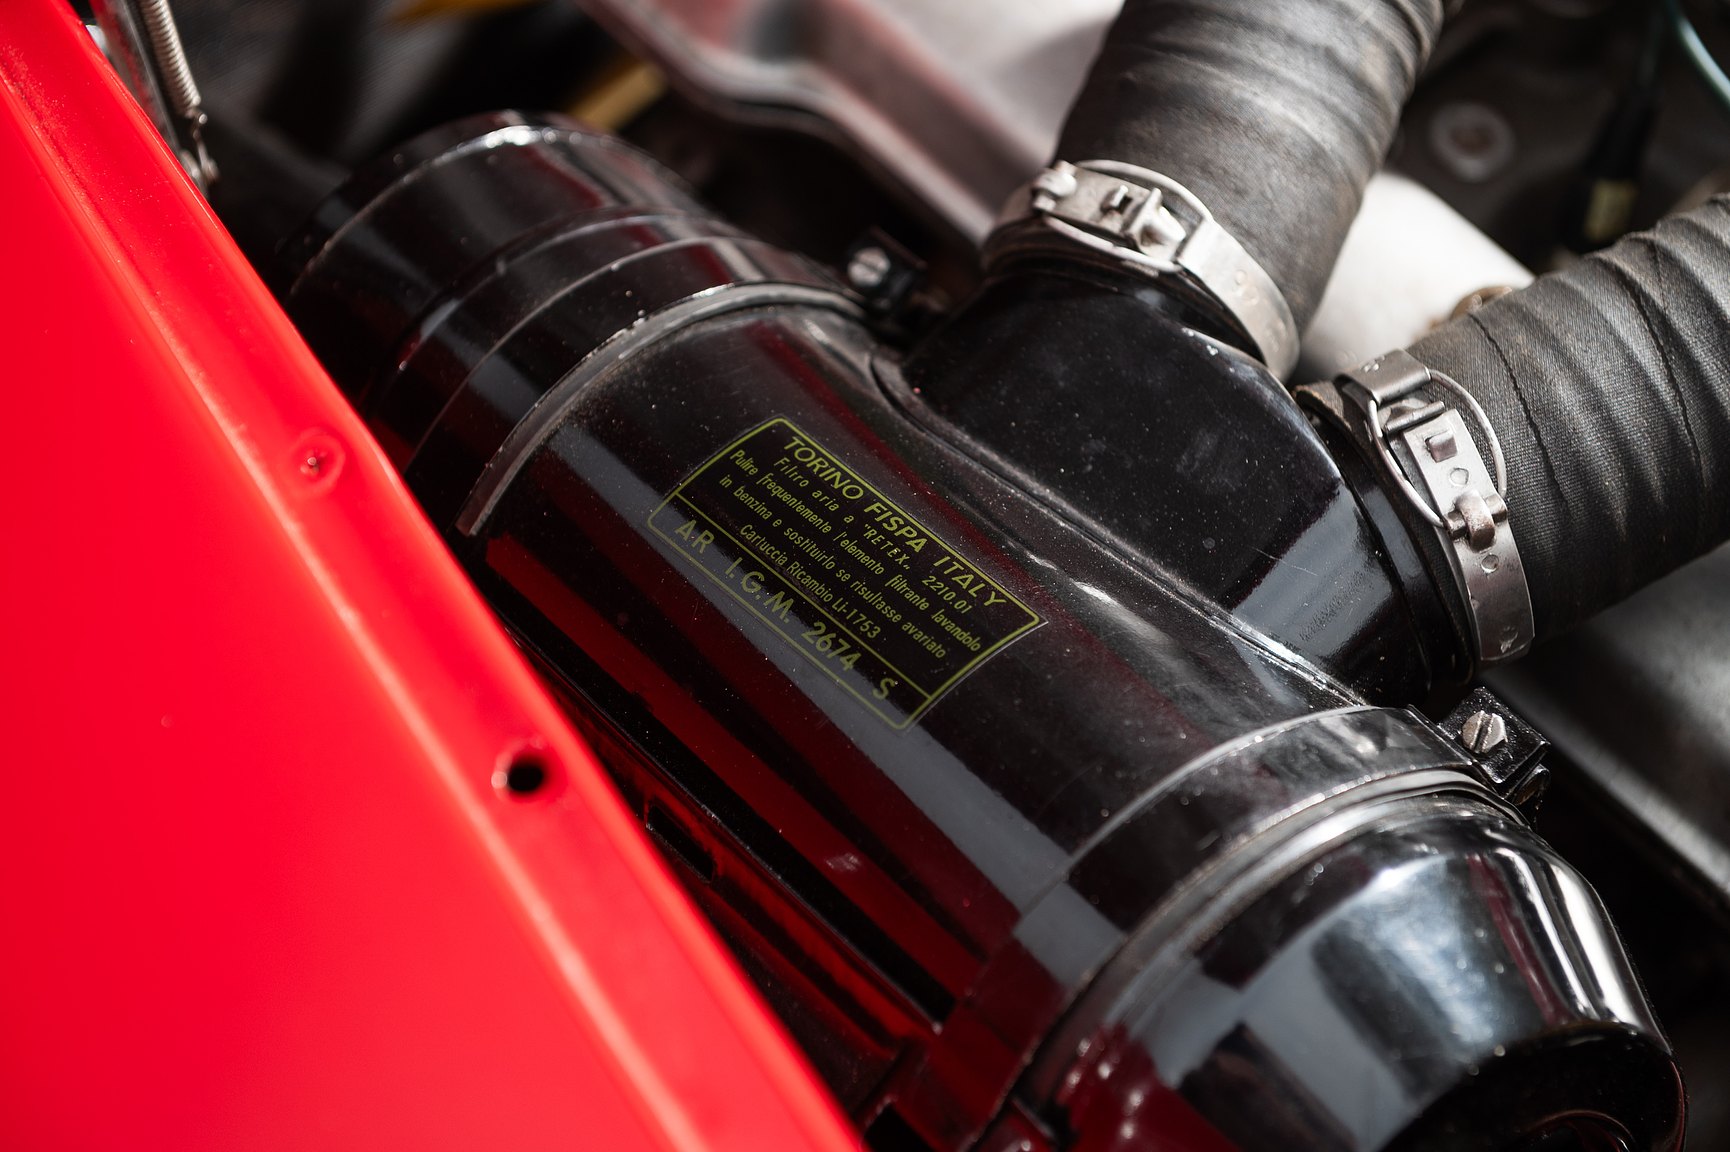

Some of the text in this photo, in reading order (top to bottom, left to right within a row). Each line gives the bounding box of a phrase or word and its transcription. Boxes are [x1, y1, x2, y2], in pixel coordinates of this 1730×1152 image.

[720, 475, 946, 658] in benzina e sostituirlo se risultasse avariato
[729, 449, 981, 651] Pulire frequentemente l'elemento filtrante lavandolo
[739, 524, 881, 638] Cartuccia Ricambio Li-1753
[784, 438, 1007, 606] TORINO FISPA ITALY
[812, 490, 840, 511] aria
[843, 514, 855, 525] a
[921, 575, 972, 615] 2210.01
[675, 519, 898, 701] AR I.G.M. 2674 S
